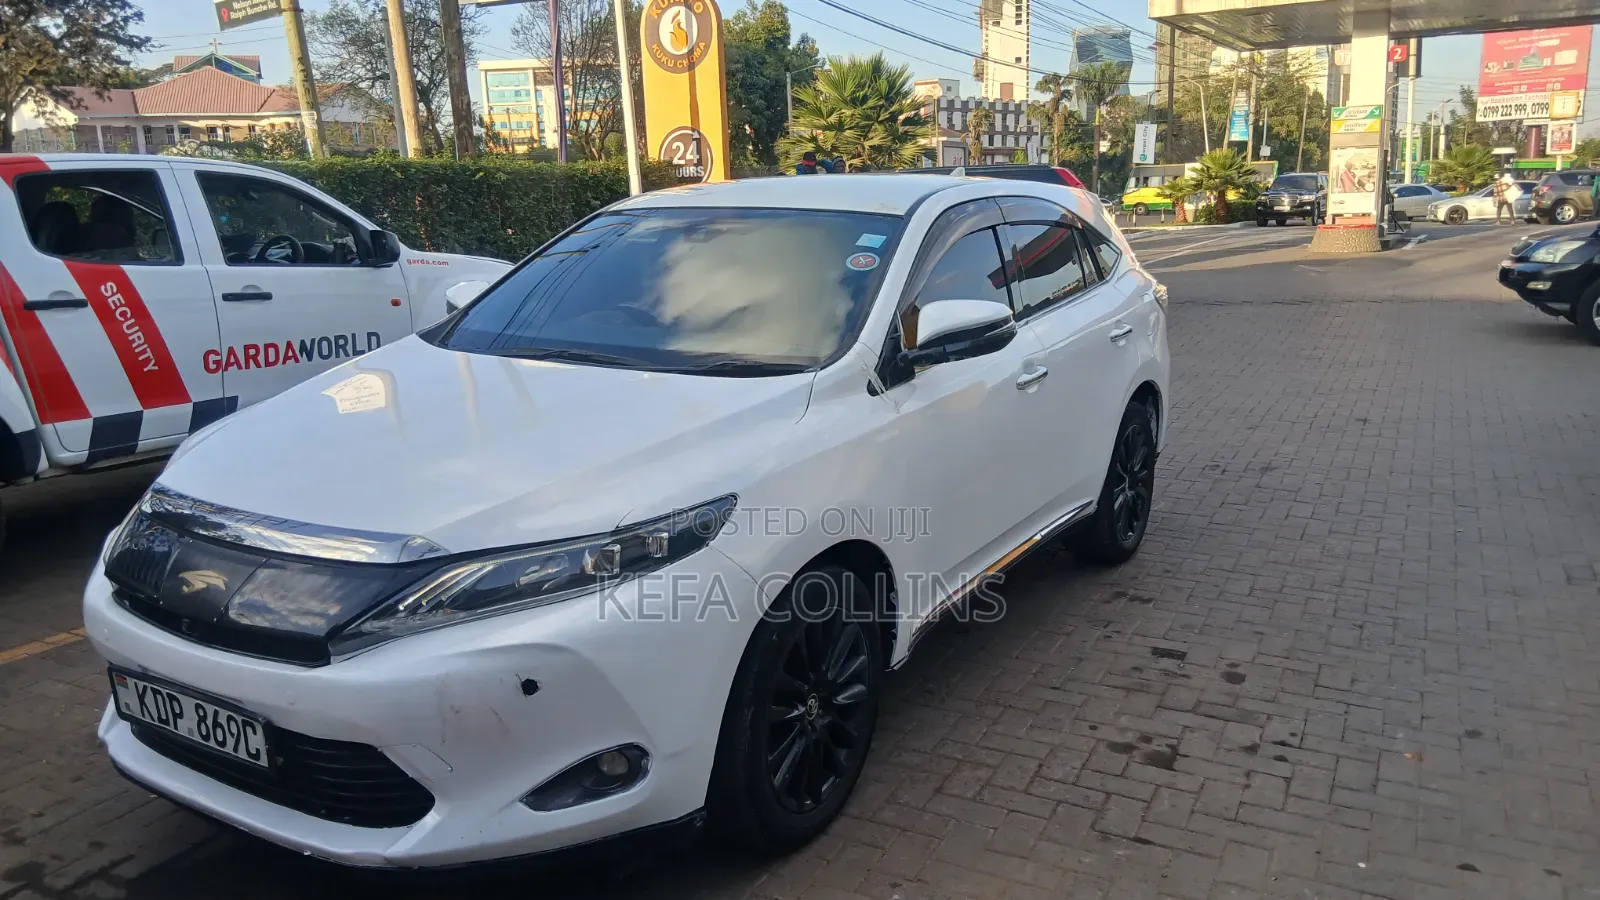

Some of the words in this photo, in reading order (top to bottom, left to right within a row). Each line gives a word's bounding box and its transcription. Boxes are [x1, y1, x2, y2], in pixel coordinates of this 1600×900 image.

[230, 10, 247, 20] Ralph
[649, 0, 704, 19] KUO
[652, 44, 675, 67] KUKU
[677, 42, 706, 67] CHOMA
[1393, 48, 1402, 60] 2
[1524, 94, 1550, 102] Technol
[1500, 104, 1513, 117] 222
[1531, 102, 1550, 115] 0799
[672, 141, 700, 165] 24
[669, 166, 705, 178] OURS
[101, 281, 159, 372] SECURITY
[203, 331, 381, 374] GARDAWORLD
[134, 681, 184, 732] KDP
[195, 702, 262, 762] 869C
